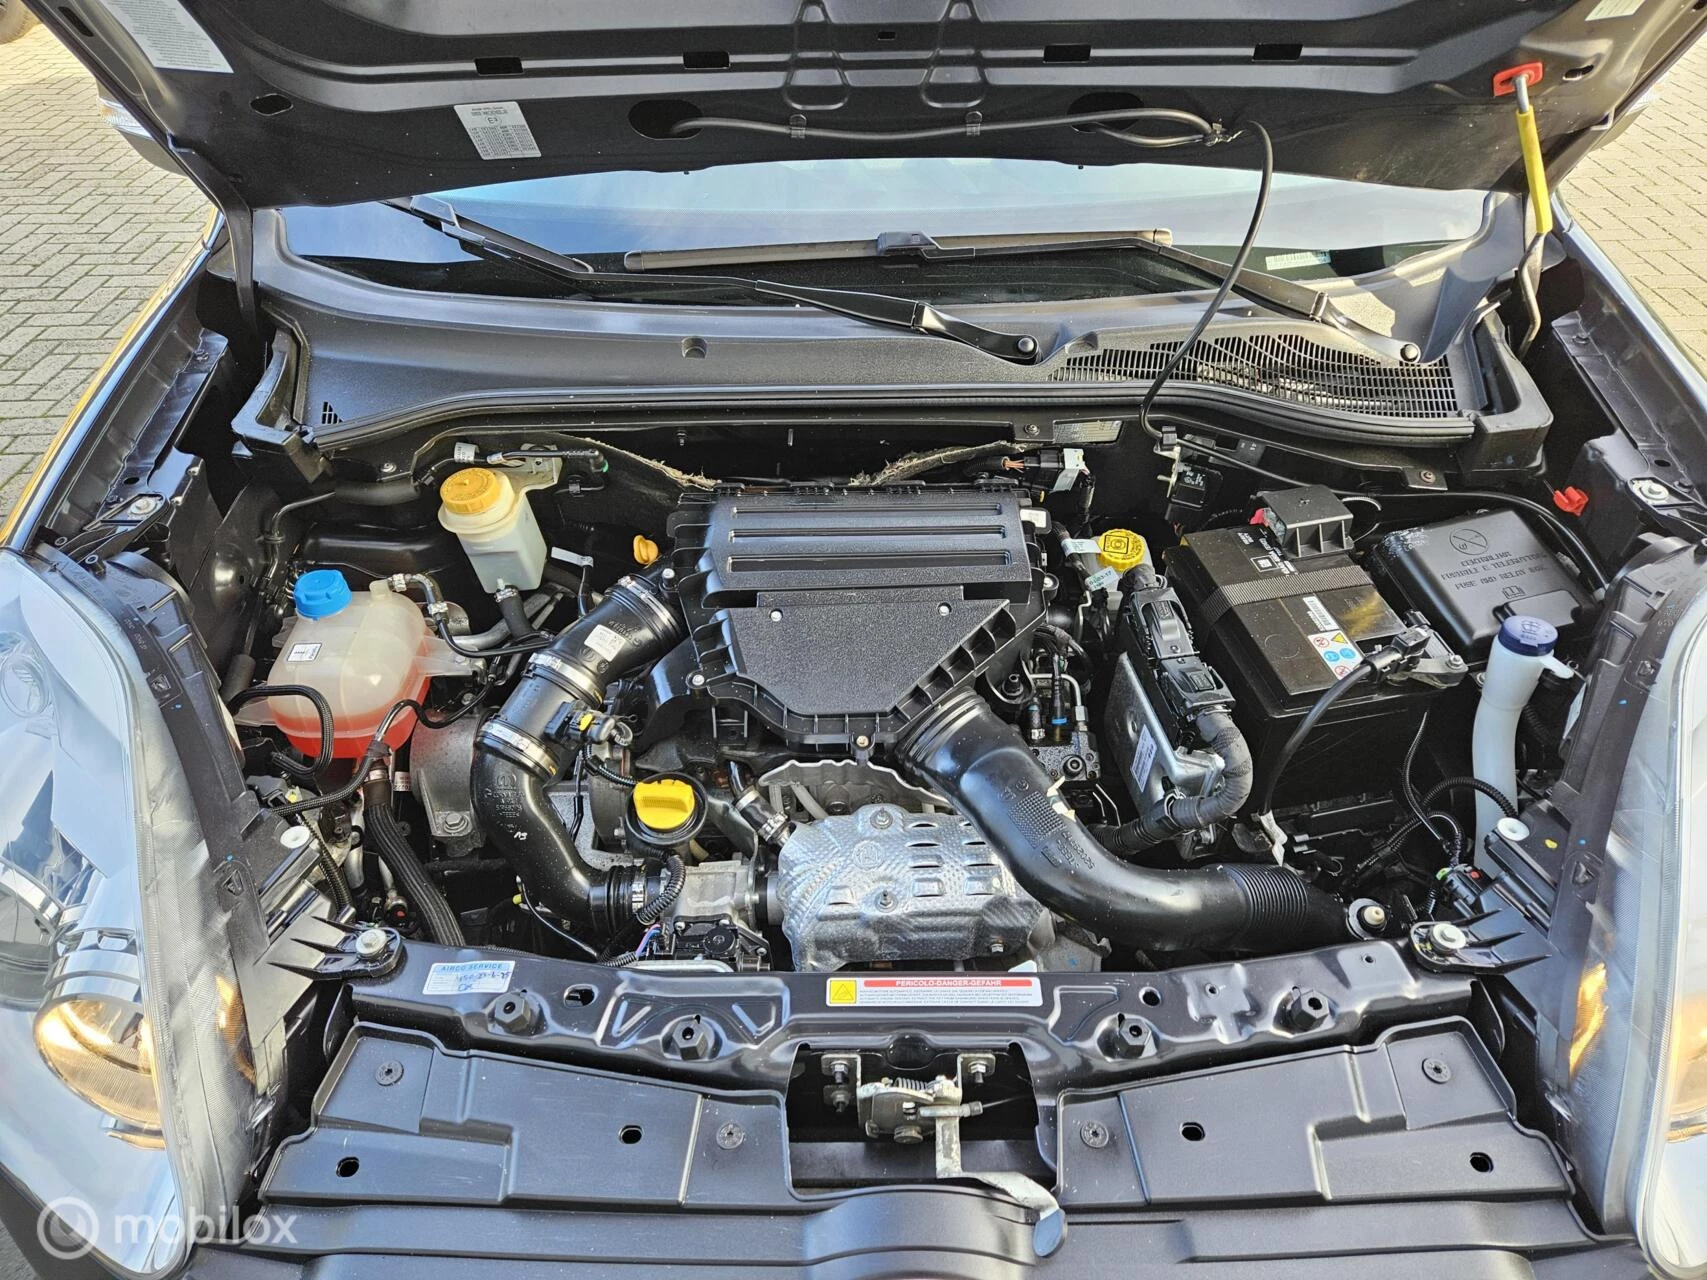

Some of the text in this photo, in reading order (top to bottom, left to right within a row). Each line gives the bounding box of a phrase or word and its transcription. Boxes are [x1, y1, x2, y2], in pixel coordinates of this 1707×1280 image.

[1455, 580, 1479, 591] FUSE
[1480, 576, 1497, 585] AND
[1499, 569, 1528, 580] RELAY
